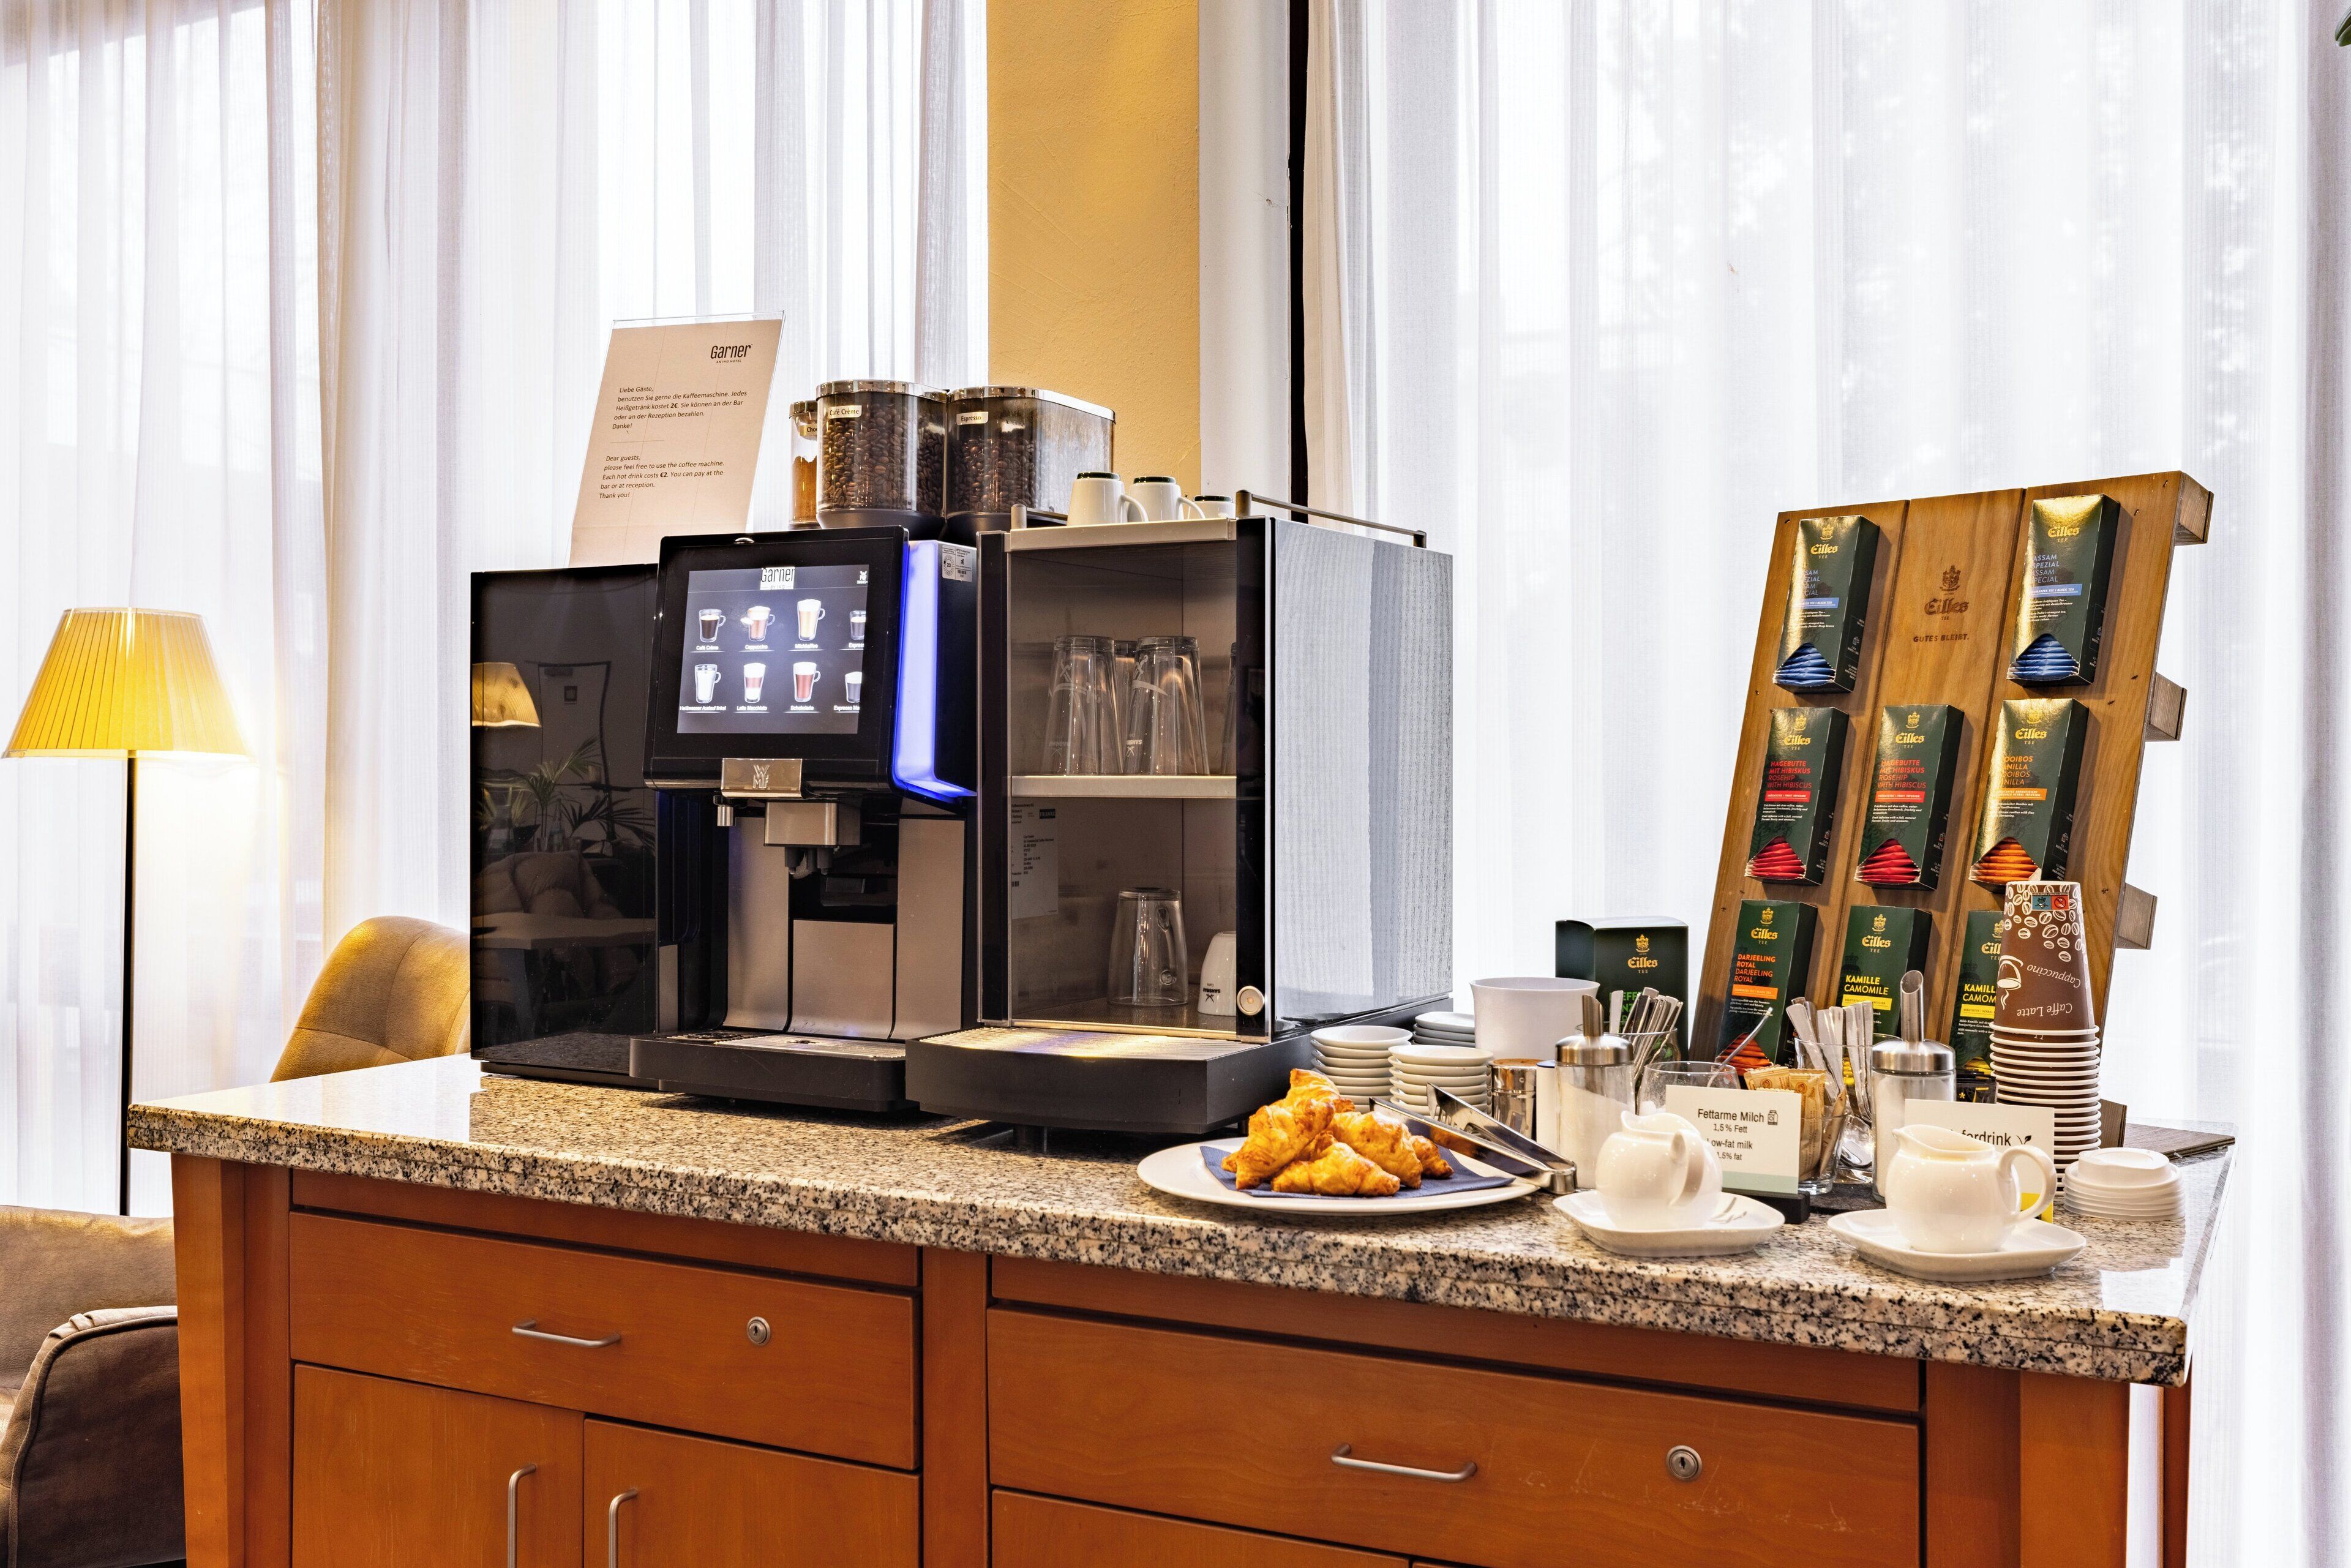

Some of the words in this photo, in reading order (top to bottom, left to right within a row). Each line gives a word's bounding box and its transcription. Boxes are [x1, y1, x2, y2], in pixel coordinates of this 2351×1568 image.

[710, 345, 751, 359] Garner
[2048, 525, 2080, 538] Eilles
[1811, 544, 1839, 554] Eilles
[761, 568, 795, 582] Garner
[1924, 598, 1969, 615] Eilles
[1895, 732, 1925, 743] Eilles
[2015, 727, 2048, 739] Eilles
[1784, 735, 1811, 745] Eilles
[753, 765, 770, 788] WMF
[1751, 928, 1778, 939] Eilles
[1862, 936, 1891, 948] Eilles
[1981, 942, 2001, 955] Eill
[1627, 956, 1658, 968] Eilles
[1738, 954, 1775, 962] DARJEELING
[1735, 969, 1773, 977] DARJEELING
[2027, 964, 2081, 988] Cappuccino
[1845, 975, 1880, 985] KAMILLE
[1844, 984, 1889, 995] CAMOMILE
[1964, 984, 1997, 993] KAMILL
[1963, 993, 1996, 1003] CAMOM
[2017, 1007, 2044, 1017] Latte
[2047, 1002, 2072, 1016] Caffe
[1698, 1109, 1737, 1120] Fettarme
[1740, 1112, 1764, 1122] Milch
[1707, 1138, 1734, 1149] ow-fat
[1736, 1141, 1753, 1150] milk
[1951, 1130, 2011, 1146] frdrink
